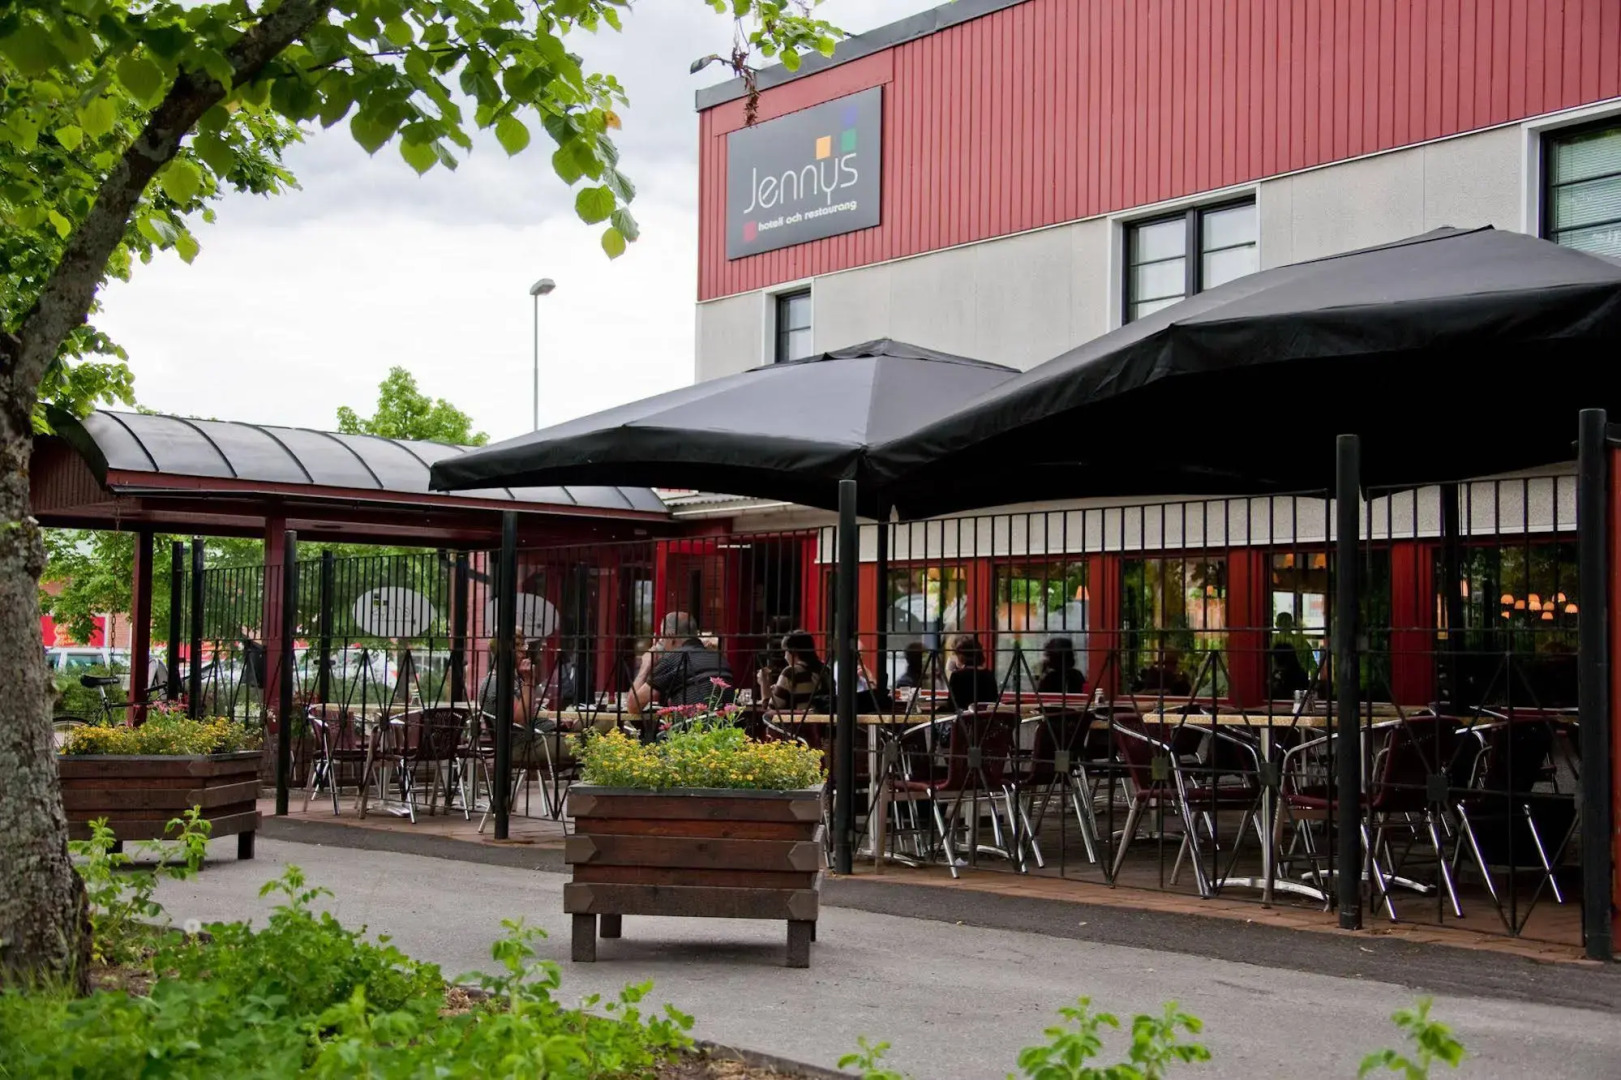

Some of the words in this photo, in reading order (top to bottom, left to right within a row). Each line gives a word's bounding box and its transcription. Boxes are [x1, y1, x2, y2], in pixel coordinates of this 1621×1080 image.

[743, 153, 858, 214] Jennys
[786, 212, 802, 224] och
[804, 200, 857, 220] restaurang
